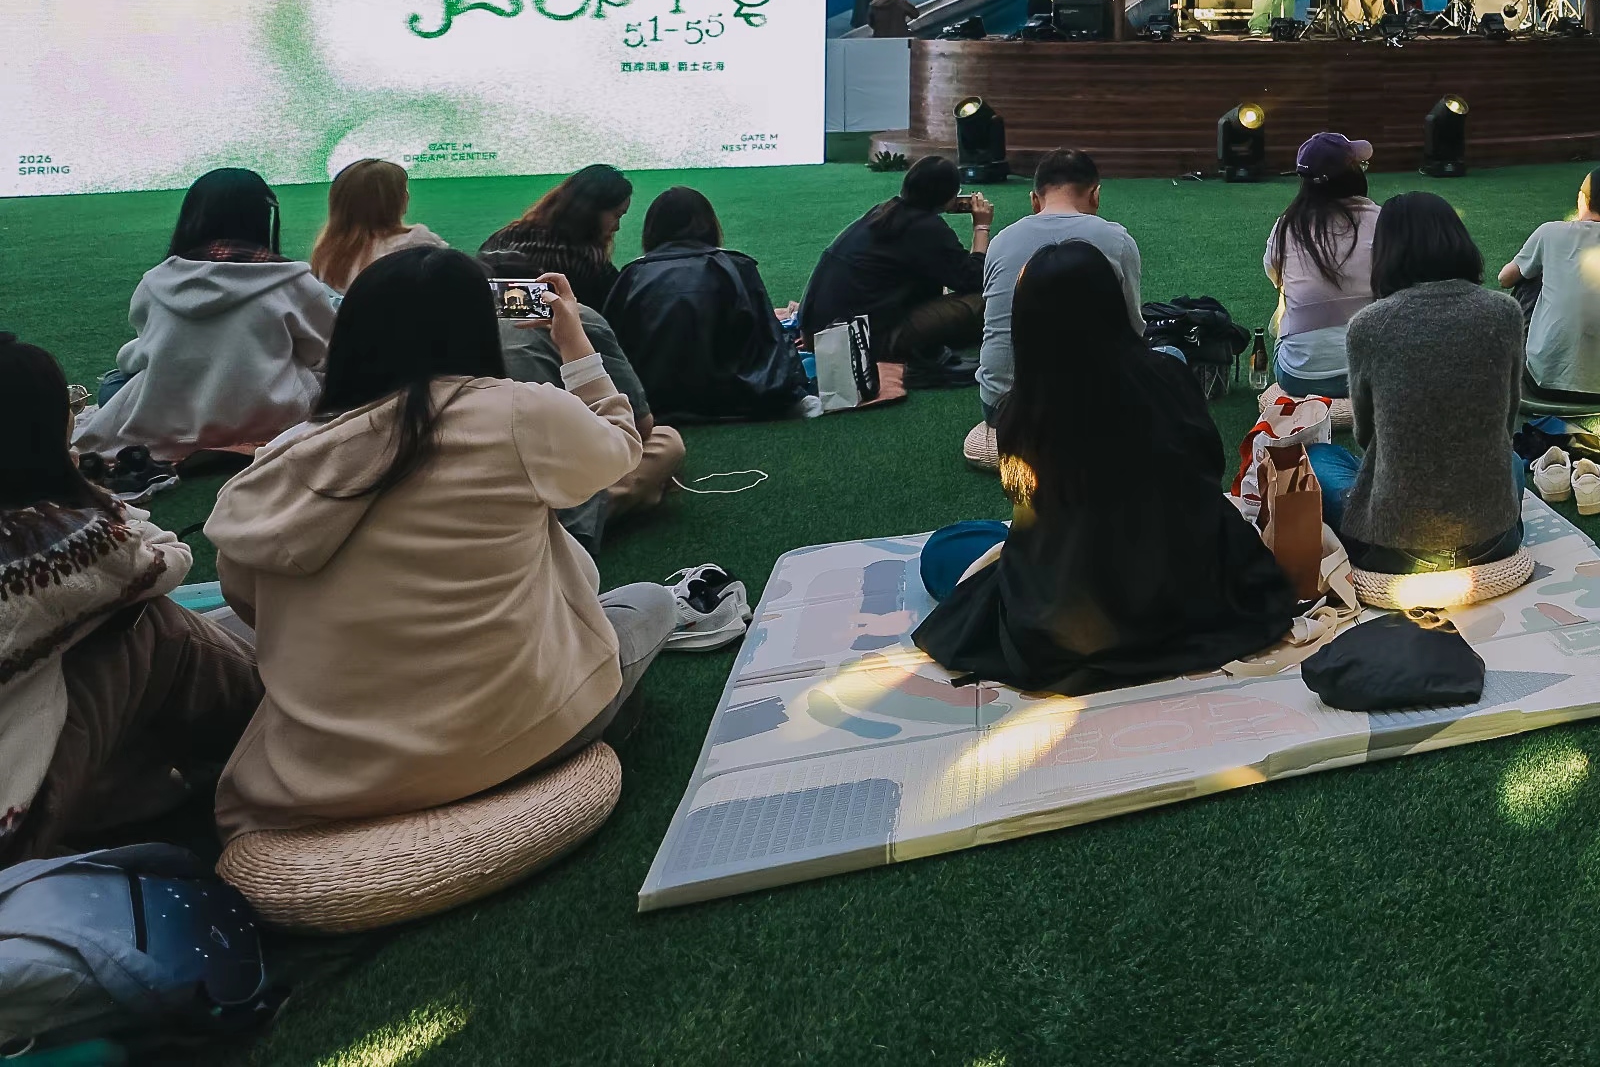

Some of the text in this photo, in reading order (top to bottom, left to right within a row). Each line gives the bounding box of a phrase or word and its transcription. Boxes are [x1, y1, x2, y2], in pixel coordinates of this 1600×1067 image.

[740, 133, 779, 142] GATE M
[428, 142, 473, 151] GATE M
[721, 143, 777, 152] NEST PARK
[18, 155, 52, 164] 2026
[403, 151, 497, 163] DREAM CENTER
[18, 165, 71, 175] SPRING
